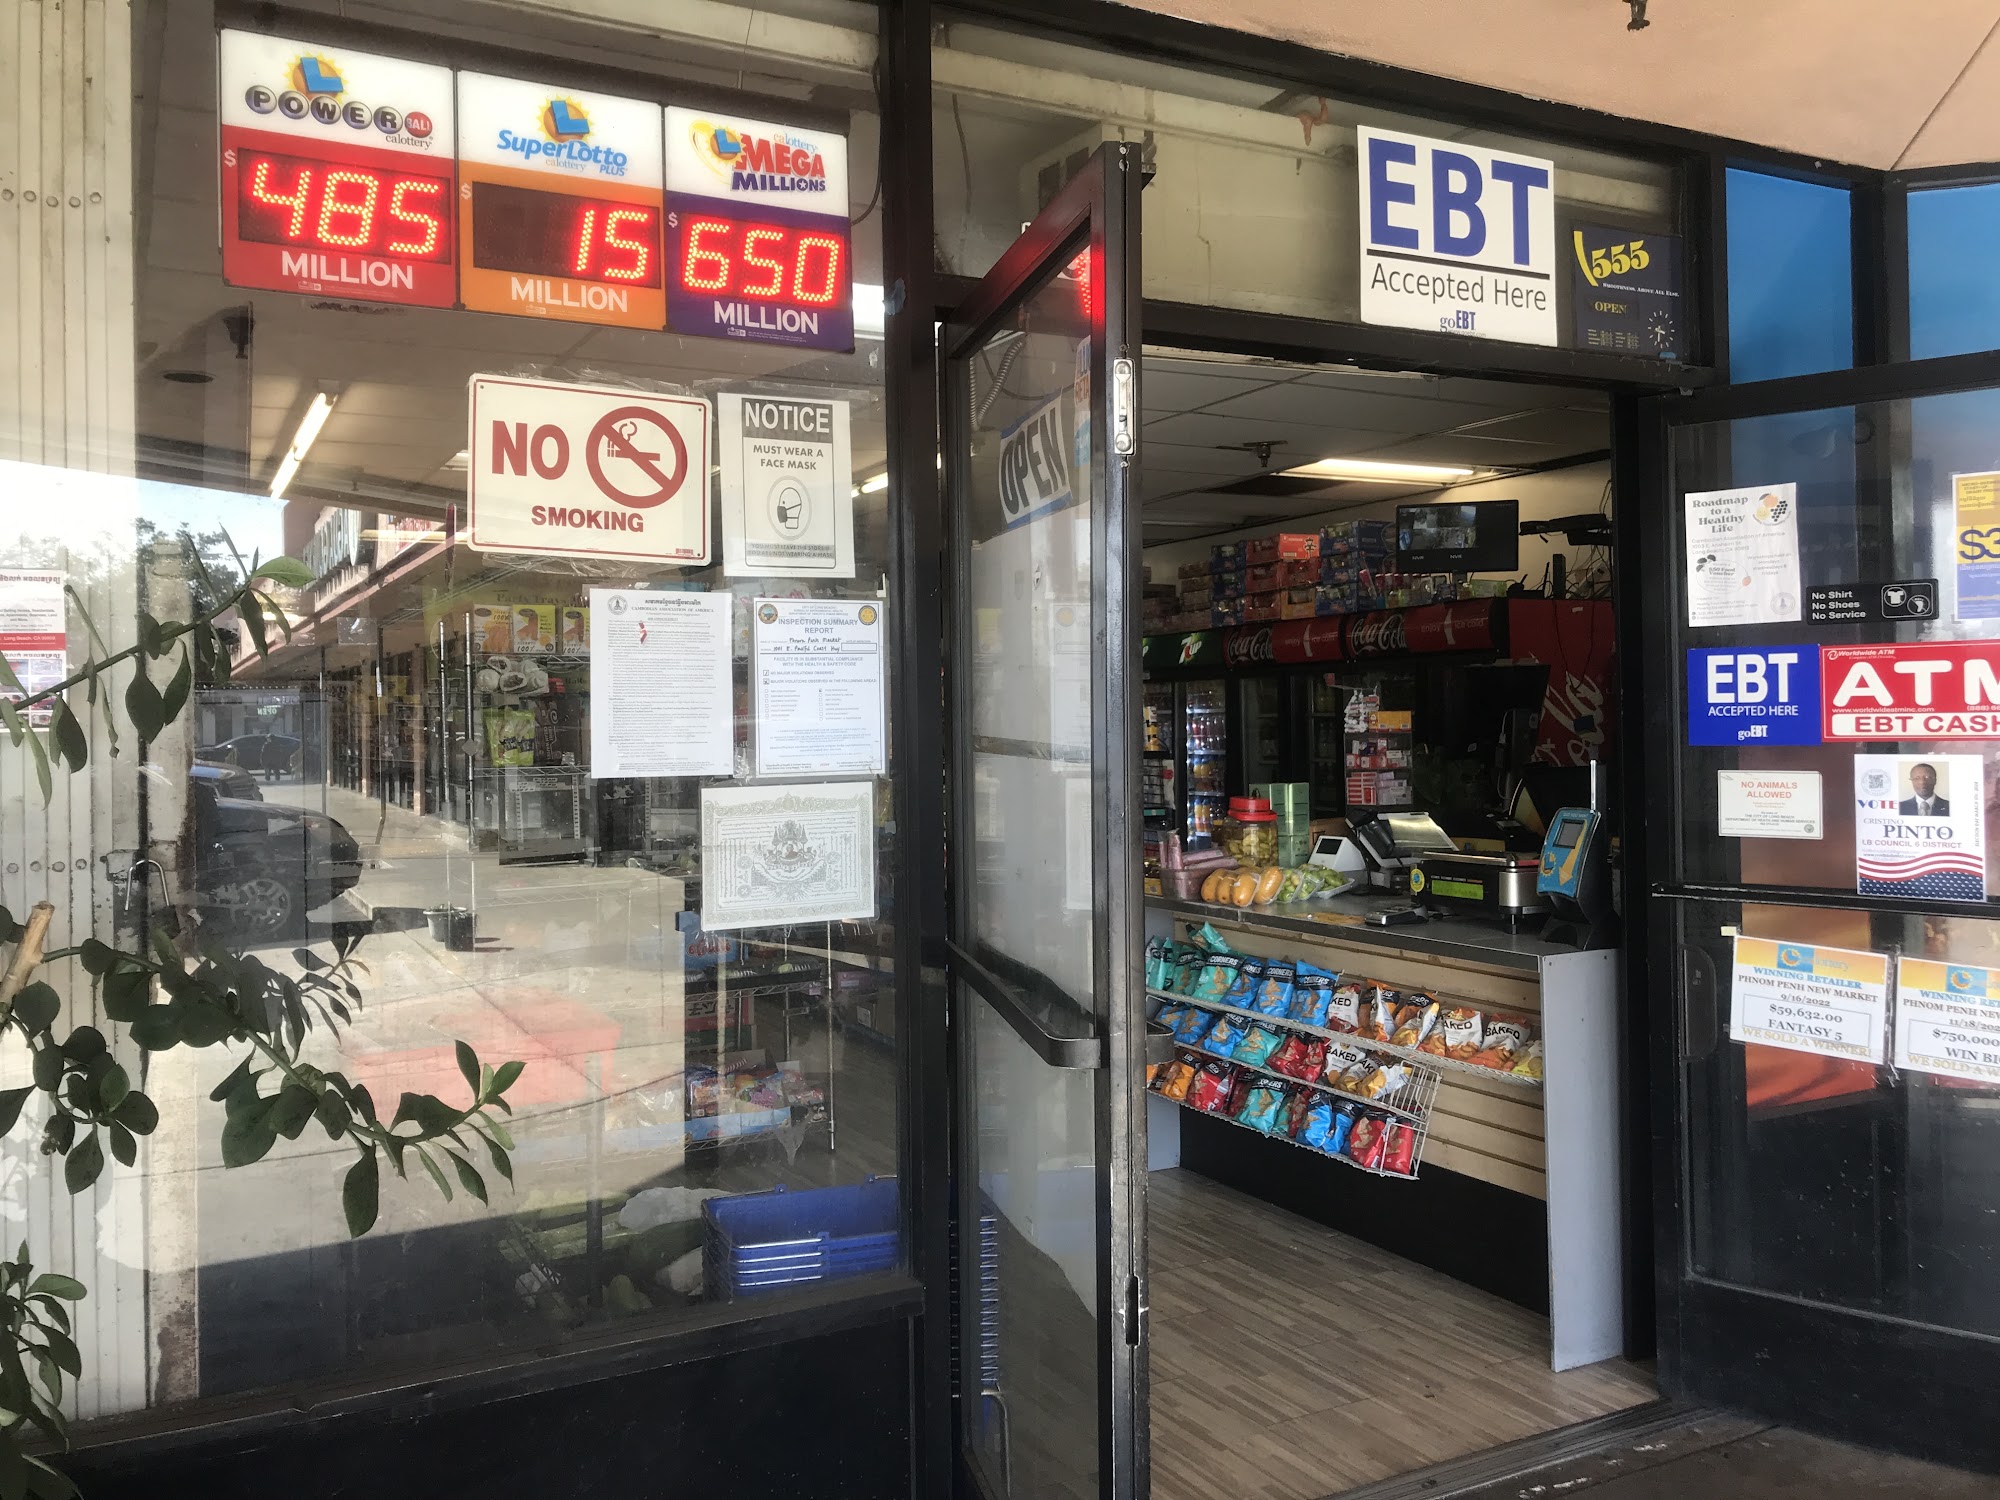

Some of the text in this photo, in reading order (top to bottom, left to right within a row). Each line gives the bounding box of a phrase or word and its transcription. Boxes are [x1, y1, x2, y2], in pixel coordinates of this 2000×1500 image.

[497, 130, 628, 167] SuperLotto
[733, 133, 826, 179] MEGA
[600, 163, 626, 177] PLUS
[731, 171, 826, 191] MILLIONS
[252, 162, 439, 254] 485
[1368, 137, 1549, 267] EBT
[576, 209, 649, 280] 15
[684, 221, 840, 303] 650
[1591, 240, 1650, 279] 555
[281, 250, 413, 290] MILLION
[511, 276, 628, 313] MILLION
[1370, 262, 1547, 311] Accepted Here
[1594, 301, 1628, 314] OPEN
[713, 300, 819, 335] MILLION
[1439, 309, 1476, 333] goEBT
[744, 401, 830, 433] NOTICE
[492, 419, 570, 481] NO
[752, 444, 824, 458] MUST WEAR A
[760, 458, 817, 470] FACE MASK
[1000, 407, 1067, 515] OPEN
[1692, 496, 1749, 509] Roadmap
[1710, 507, 1722, 515] to
[531, 505, 644, 533] SMOKING
[1698, 514, 1746, 526] Healthy
[1711, 525, 1734, 534] Life
[1811, 590, 1853, 600] No Shirt
[1811, 600, 1860, 610] No Shoes
[778, 618, 822, 626] INSPECTION
[1811, 610, 1867, 620] No Service
[1706, 652, 1799, 705] EBT
[1707, 704, 1799, 717] ACCEPTED HERE
[1737, 724, 1768, 741] goEBT
[1854, 715, 1914, 733] EBT
[1741, 781, 1798, 790] NO ANIMALS
[1746, 790, 1792, 799] ALLOWED
[1857, 799, 1898, 809] VOTE
[1883, 824, 1954, 840] PINTO
[1874, 839, 1912, 848] COUNCIL
[1923, 841, 1962, 849] DISTRICT
[1211, 955, 1239, 967] CORNERS
[1266, 966, 1295, 977] CORNERS
[1754, 966, 1863, 990] WINNING RETAILER
[1738, 974, 1879, 1003] PHNOM PENH NEW MARKET
[1780, 993, 1831, 1007] 9/16/2022
[1919, 990, 1977, 1005] WINNING
[1769, 1003, 1843, 1023] $59,632.00
[1903, 998, 1978, 1016] PHNOM PENH
[1443, 1020, 1473, 1031] AKED
[1485, 1024, 1521, 1040] BAKED
[1768, 1018, 1843, 1041] FANTASY 5
[1742, 1026, 1763, 1037] WE
[1763, 1030, 1798, 1043] SOLD
[1800, 1036, 1809, 1046] A
[1944, 1046, 1979, 1061] WIN
[1907, 1054, 1931, 1066] WE
[1932, 1058, 1971, 1072] SOLD
